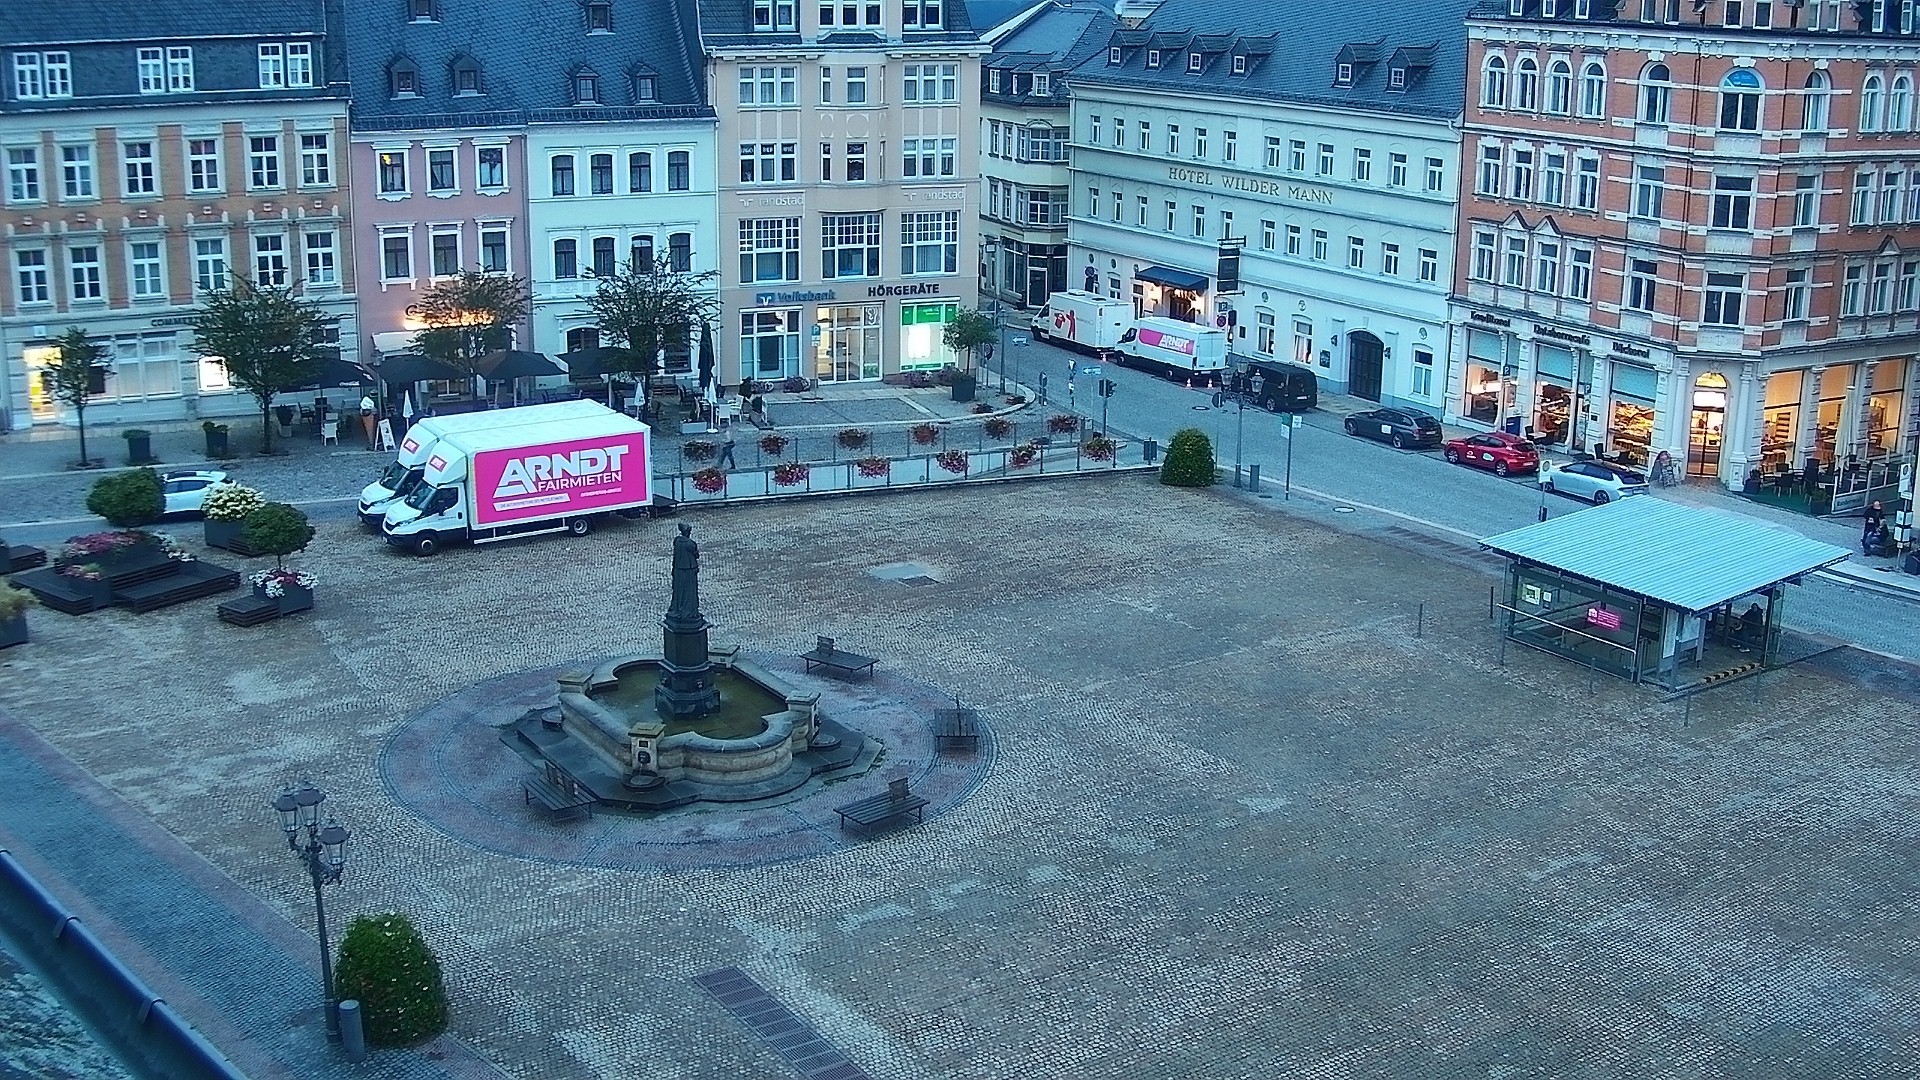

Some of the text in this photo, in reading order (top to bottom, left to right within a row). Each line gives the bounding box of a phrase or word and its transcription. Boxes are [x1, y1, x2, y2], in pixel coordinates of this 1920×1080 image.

[1168, 167, 1333, 205] HOTEL WILDER MANN
[759, 194, 804, 206] randstad
[922, 188, 965, 200] randstad
[777, 289, 836, 303] Volksbank
[867, 283, 940, 297] HÖRGERÄTE
[493, 445, 629, 498] ARNDT
[537, 471, 622, 492] FAIRMIETEN
